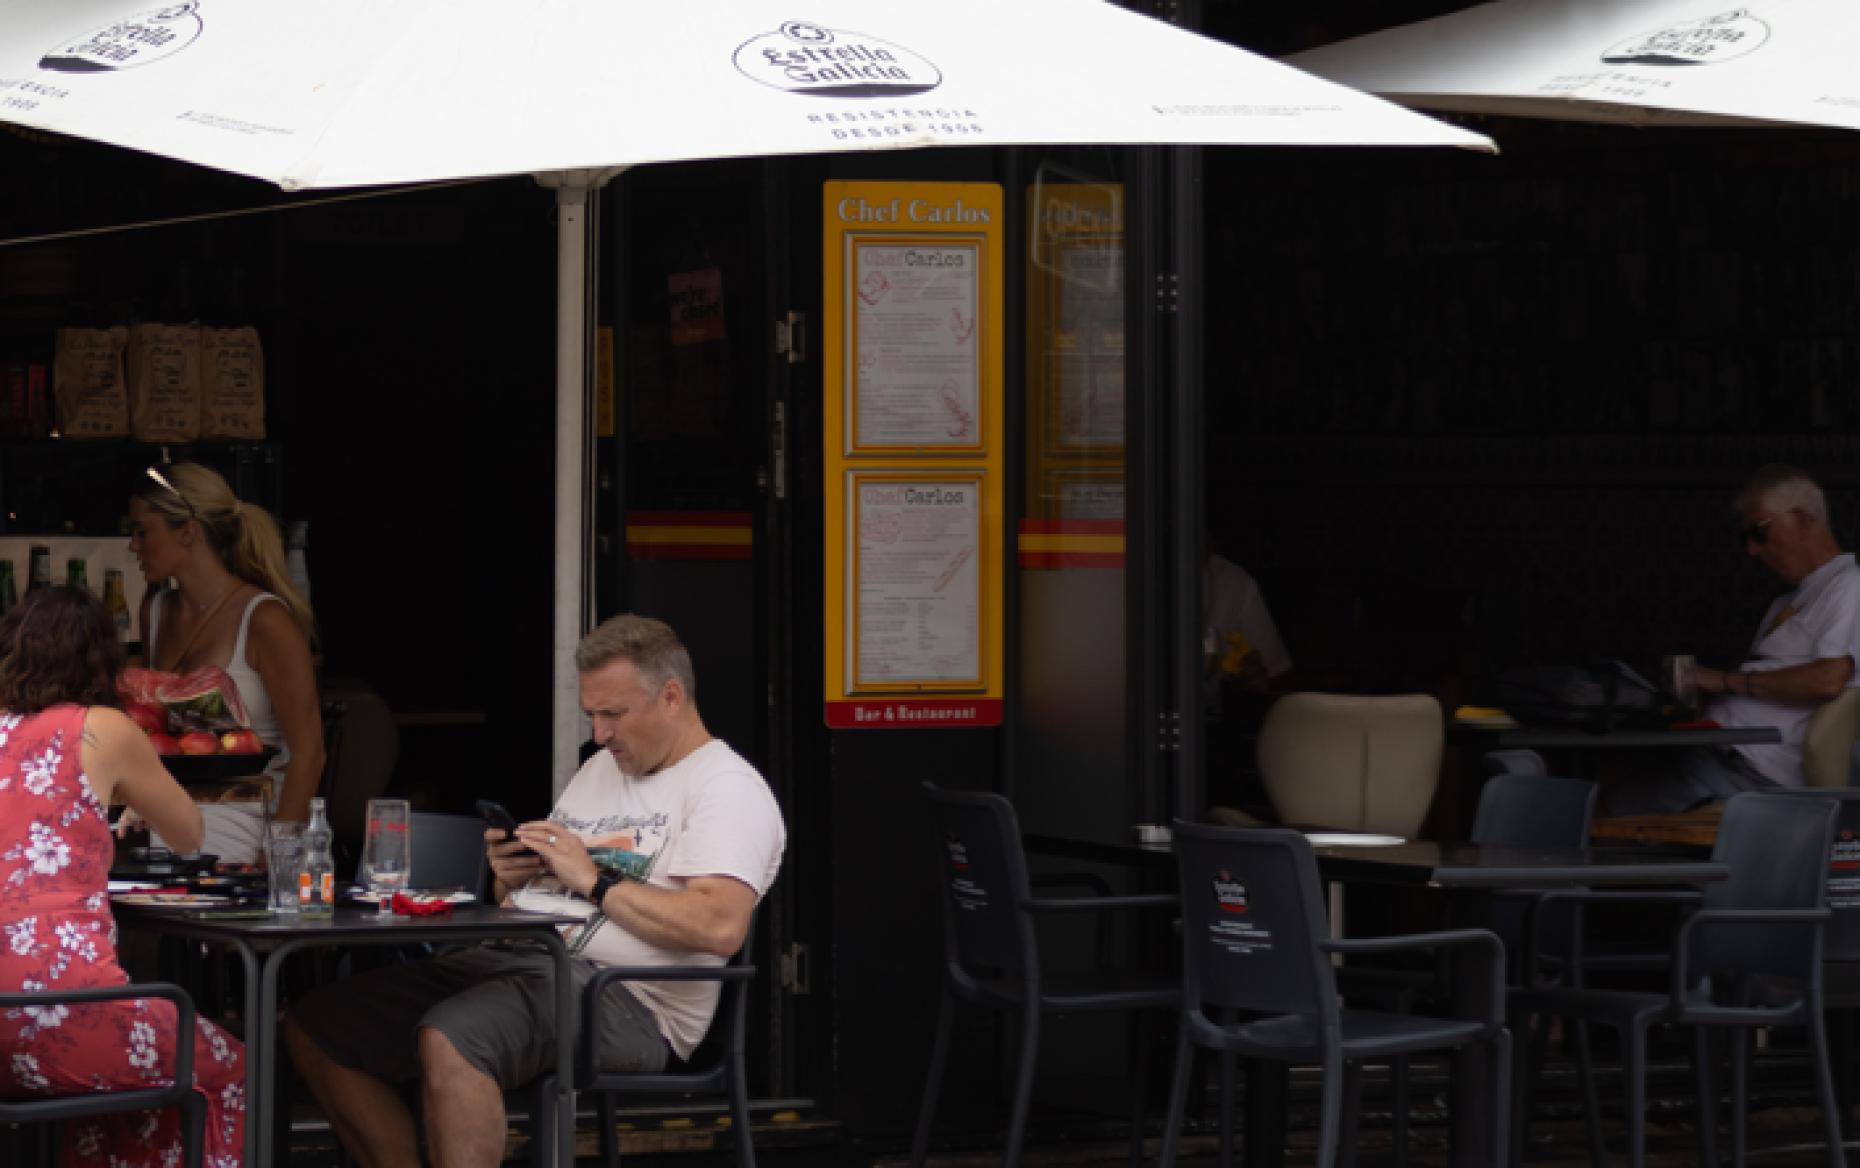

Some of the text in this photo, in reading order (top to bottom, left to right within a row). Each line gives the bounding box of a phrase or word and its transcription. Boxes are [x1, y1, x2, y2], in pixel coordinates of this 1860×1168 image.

[761, 43, 899, 66] Estrella
[784, 62, 911, 83] Galicia
[837, 197, 991, 223] Chef Carlos
[855, 706, 881, 722] Bar
